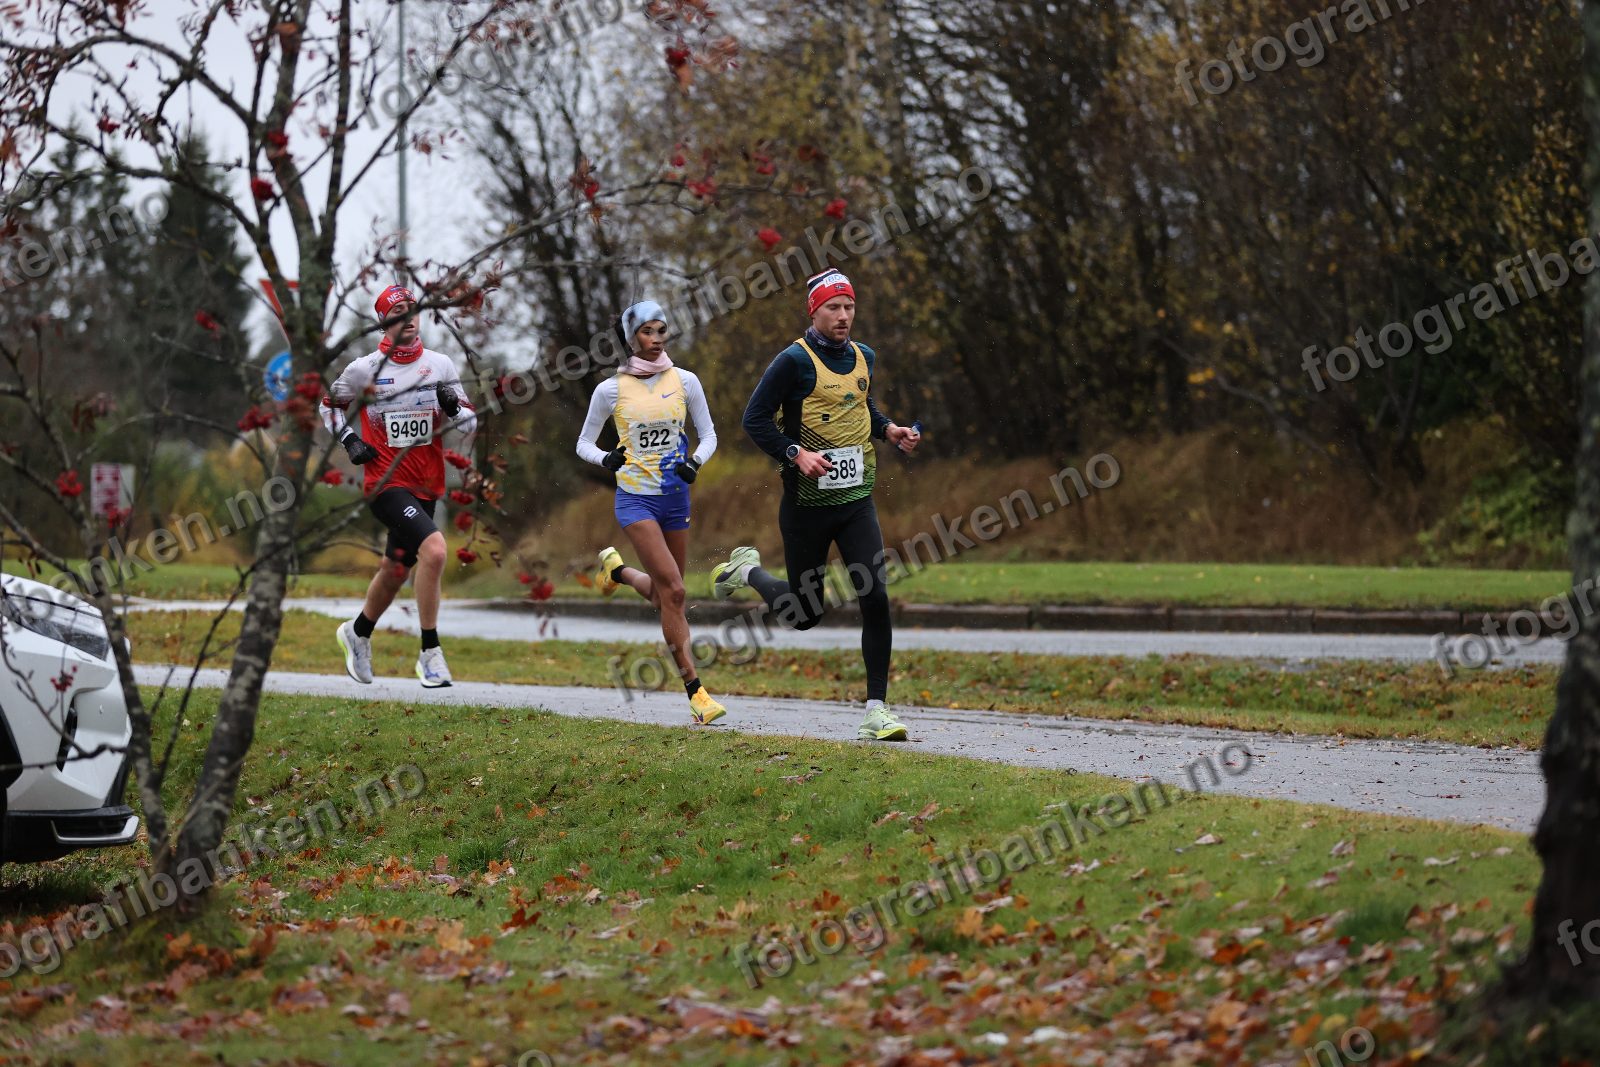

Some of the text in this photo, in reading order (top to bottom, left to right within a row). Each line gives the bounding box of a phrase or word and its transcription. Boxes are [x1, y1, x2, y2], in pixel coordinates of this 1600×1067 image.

[390, 420, 428, 439] 9490
[639, 428, 670, 448] 522
[829, 458, 857, 480] 589
